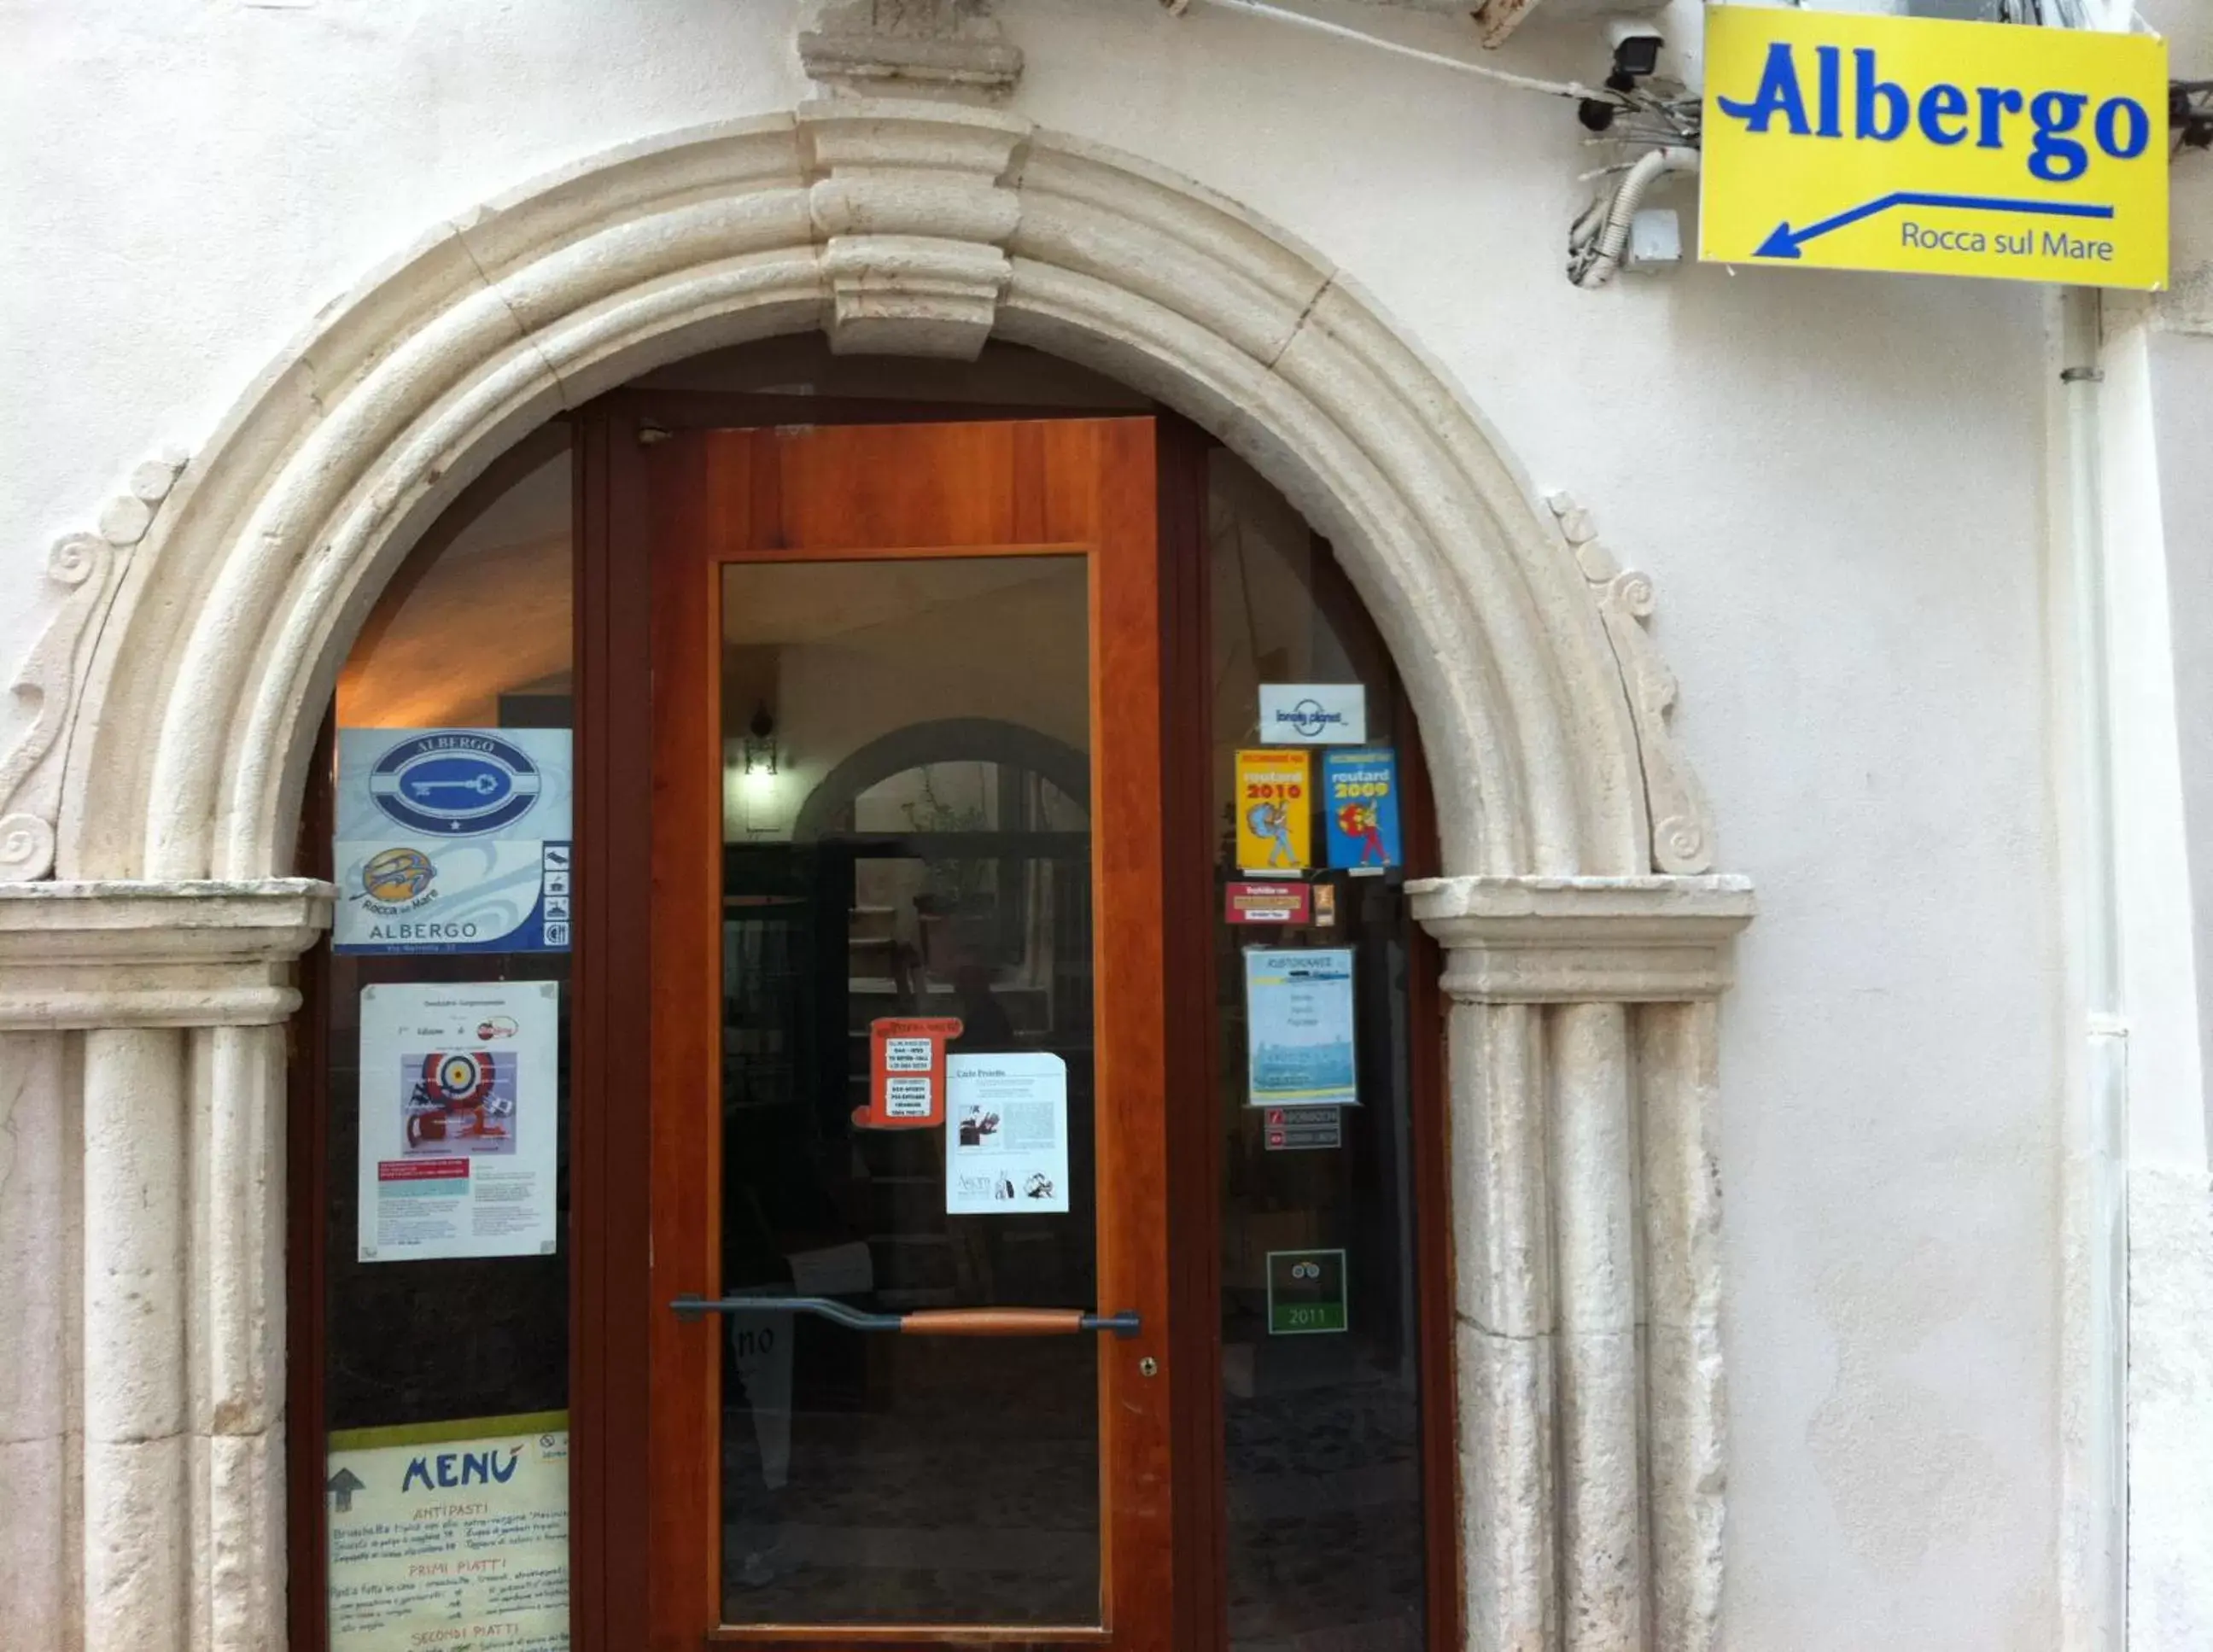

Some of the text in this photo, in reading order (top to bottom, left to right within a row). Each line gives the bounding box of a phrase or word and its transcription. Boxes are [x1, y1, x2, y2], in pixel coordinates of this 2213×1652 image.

[1716, 42, 2150, 182] Albergo
[1901, 222, 2114, 260] Rocca sul Mare
[417, 737, 495, 755] ALBERGO
[1332, 769, 1390, 783] routard
[1247, 784, 1302, 799] 2010
[1334, 783, 1390, 799] 2009
[370, 922, 476, 939] ALBERGO
[1289, 1308, 1325, 1325] 2011
[412, 1503, 488, 1521] ANTIPASTI
[409, 1558, 506, 1577] PRIMI PIATTI
[412, 1626, 466, 1646] SECONDI
[474, 1623, 518, 1639] PIATTI
